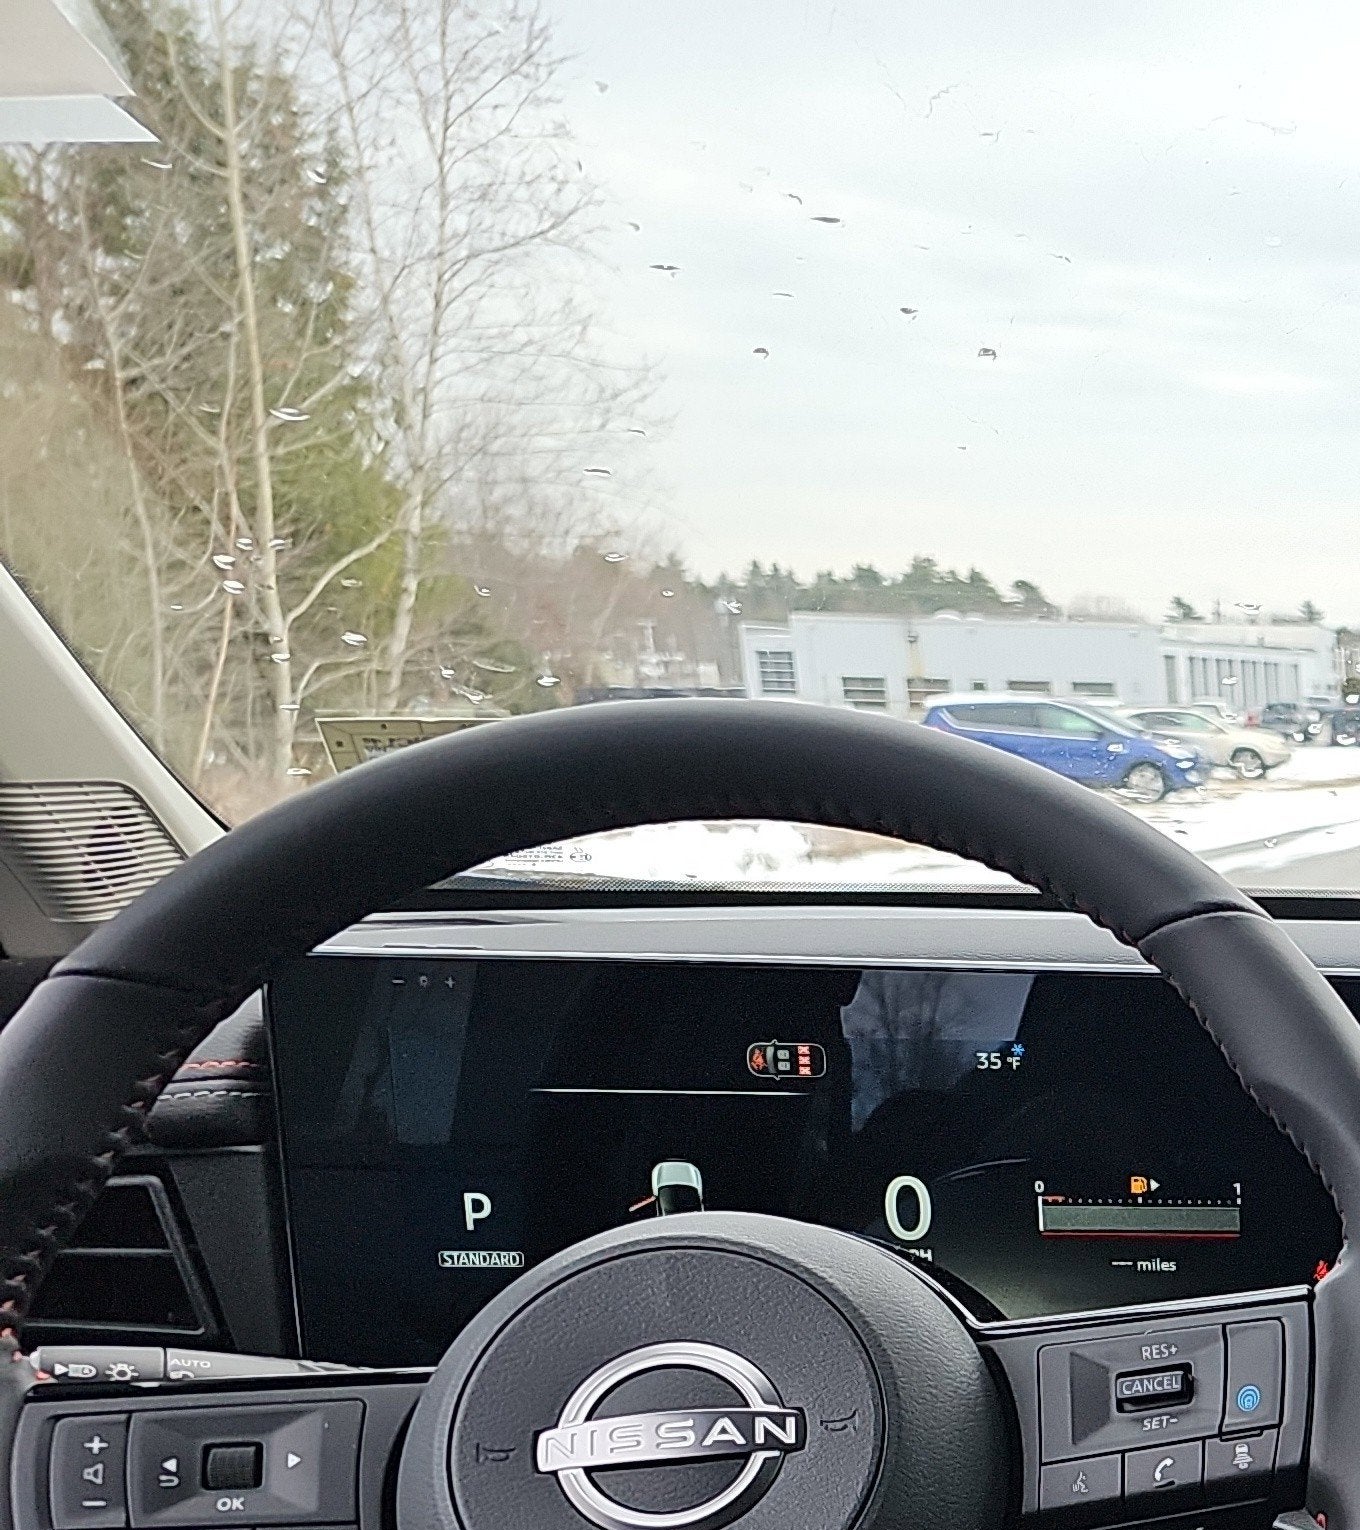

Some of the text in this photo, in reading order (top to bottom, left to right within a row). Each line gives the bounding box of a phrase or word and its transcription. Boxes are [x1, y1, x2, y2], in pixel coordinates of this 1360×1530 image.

[976, 1052, 1002, 1069] 35
[1034, 1180, 1045, 1193] 0
[1233, 1182, 1241, 1195] 1
[463, 1192, 492, 1231] P
[884, 1175, 932, 1241] 0
[442, 1252, 520, 1267] STANDARD
[1136, 1257, 1177, 1272] miles
[1141, 1343, 1178, 1361] RES+
[170, 1358, 212, 1369] AUTO
[1122, 1375, 1181, 1395] CANCEL
[543, 1415, 798, 1465] NISSAN
[215, 1497, 245, 1512] OK
